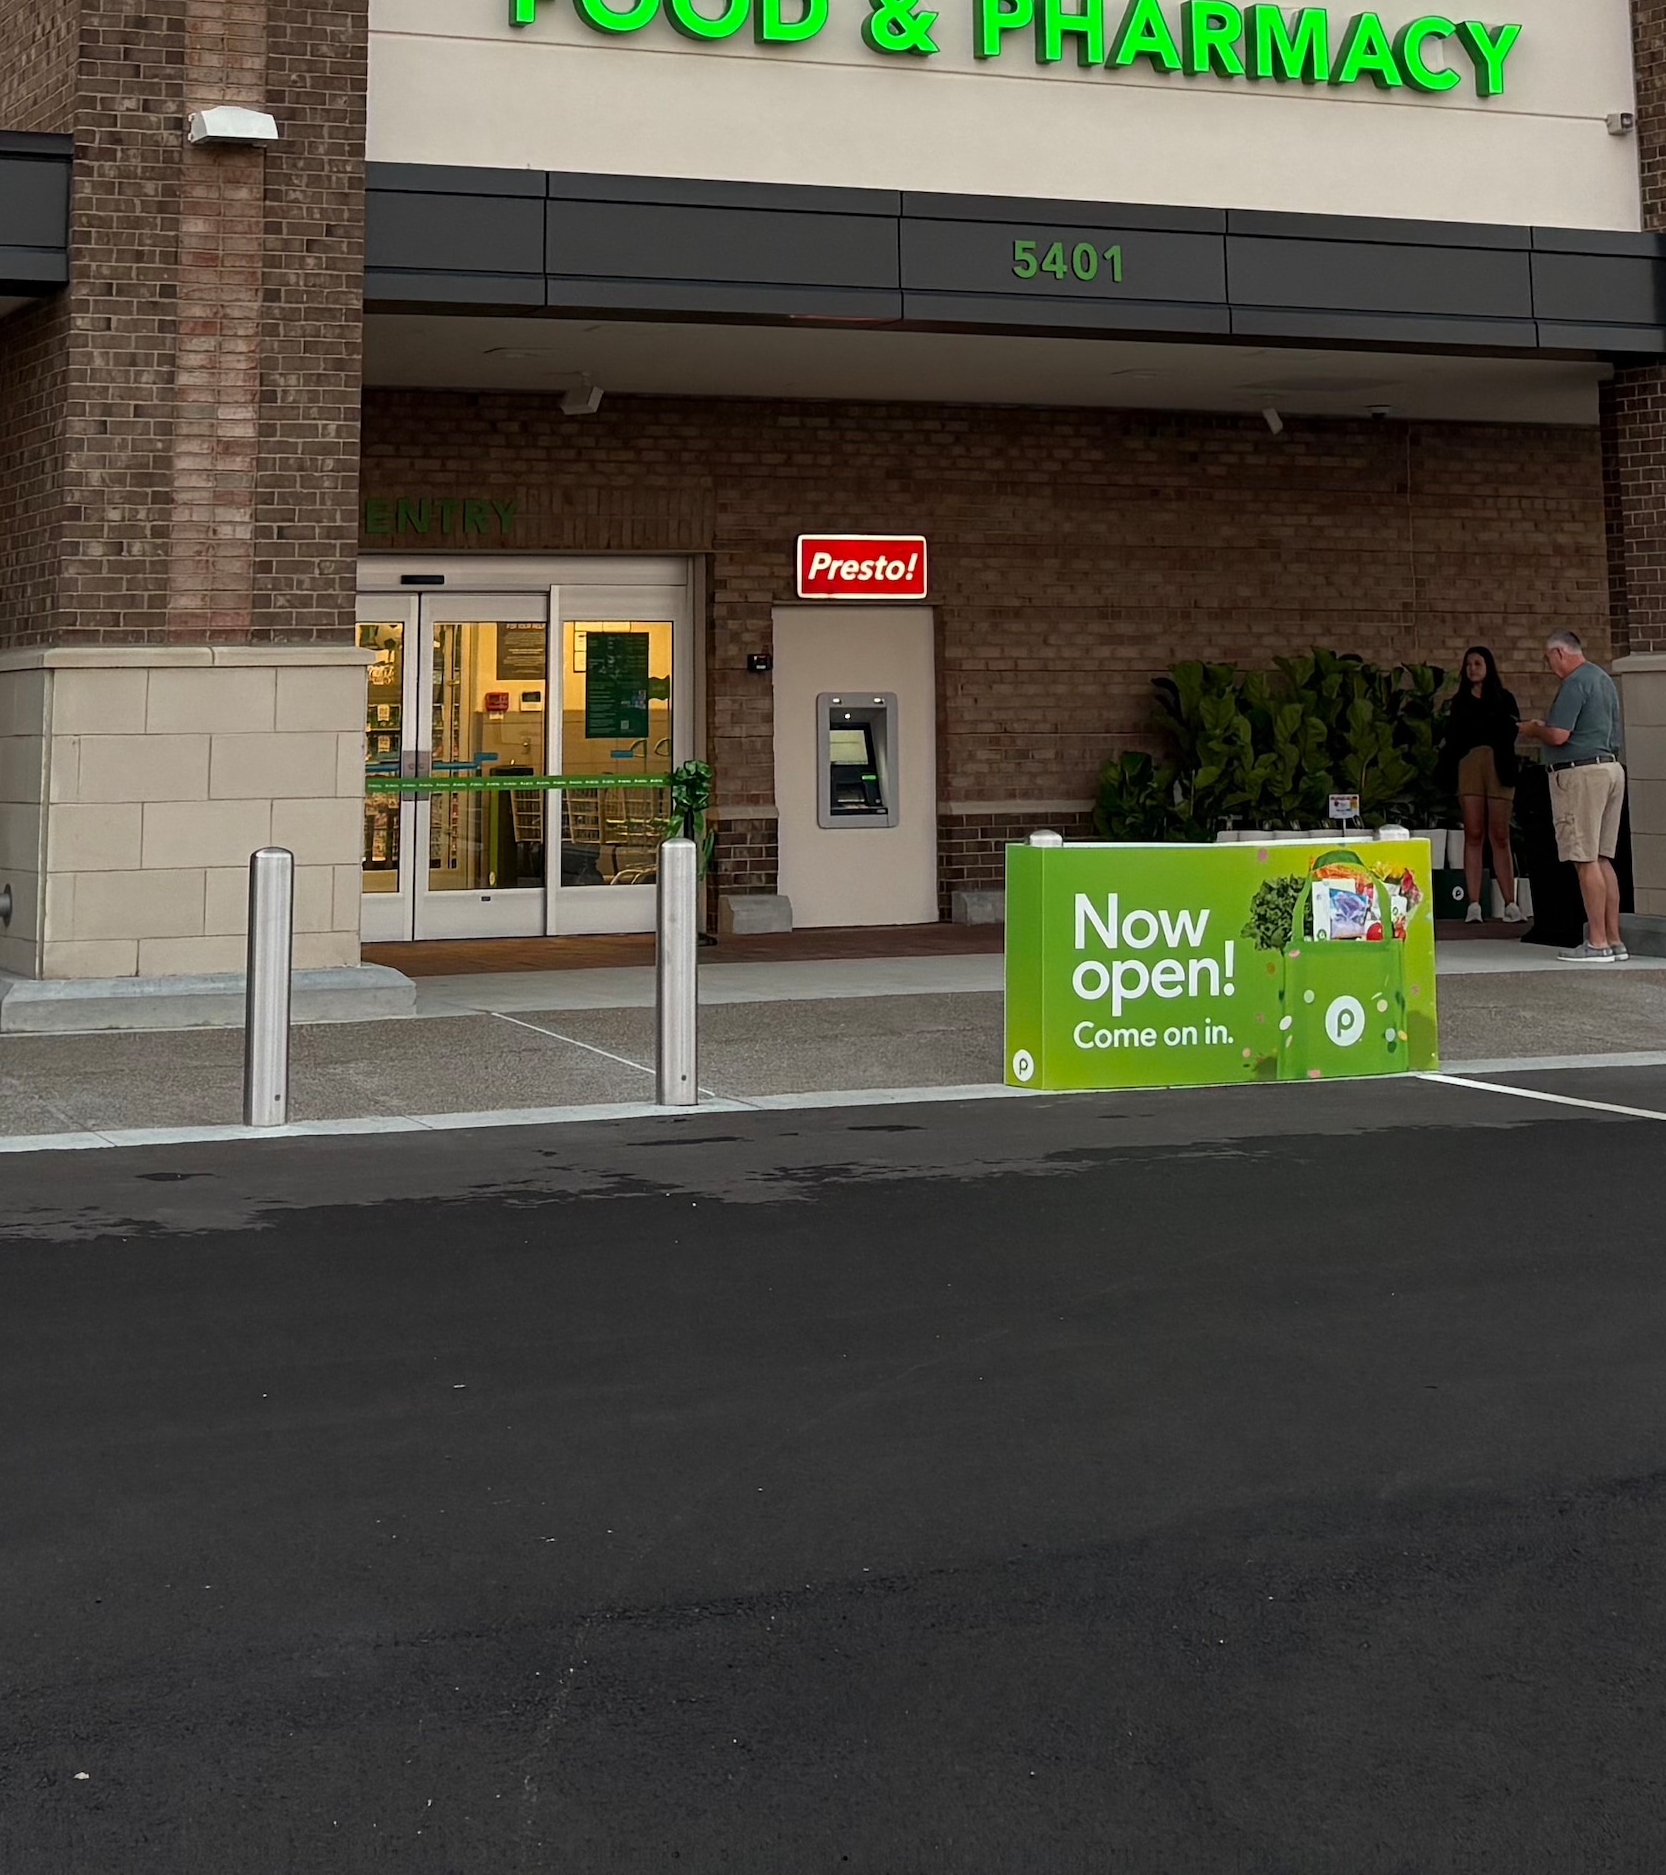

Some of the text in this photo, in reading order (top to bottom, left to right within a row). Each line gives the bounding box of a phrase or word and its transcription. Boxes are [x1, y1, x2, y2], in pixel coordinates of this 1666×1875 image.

[1012, 239, 1123, 283] 5401
[365, 497, 518, 535] ENTRY
[808, 551, 918, 581] Presto!
[1074, 892, 1211, 950] Now
[1072, 940, 1236, 1018] open!
[1073, 1017, 1235, 1050] Come on in.
